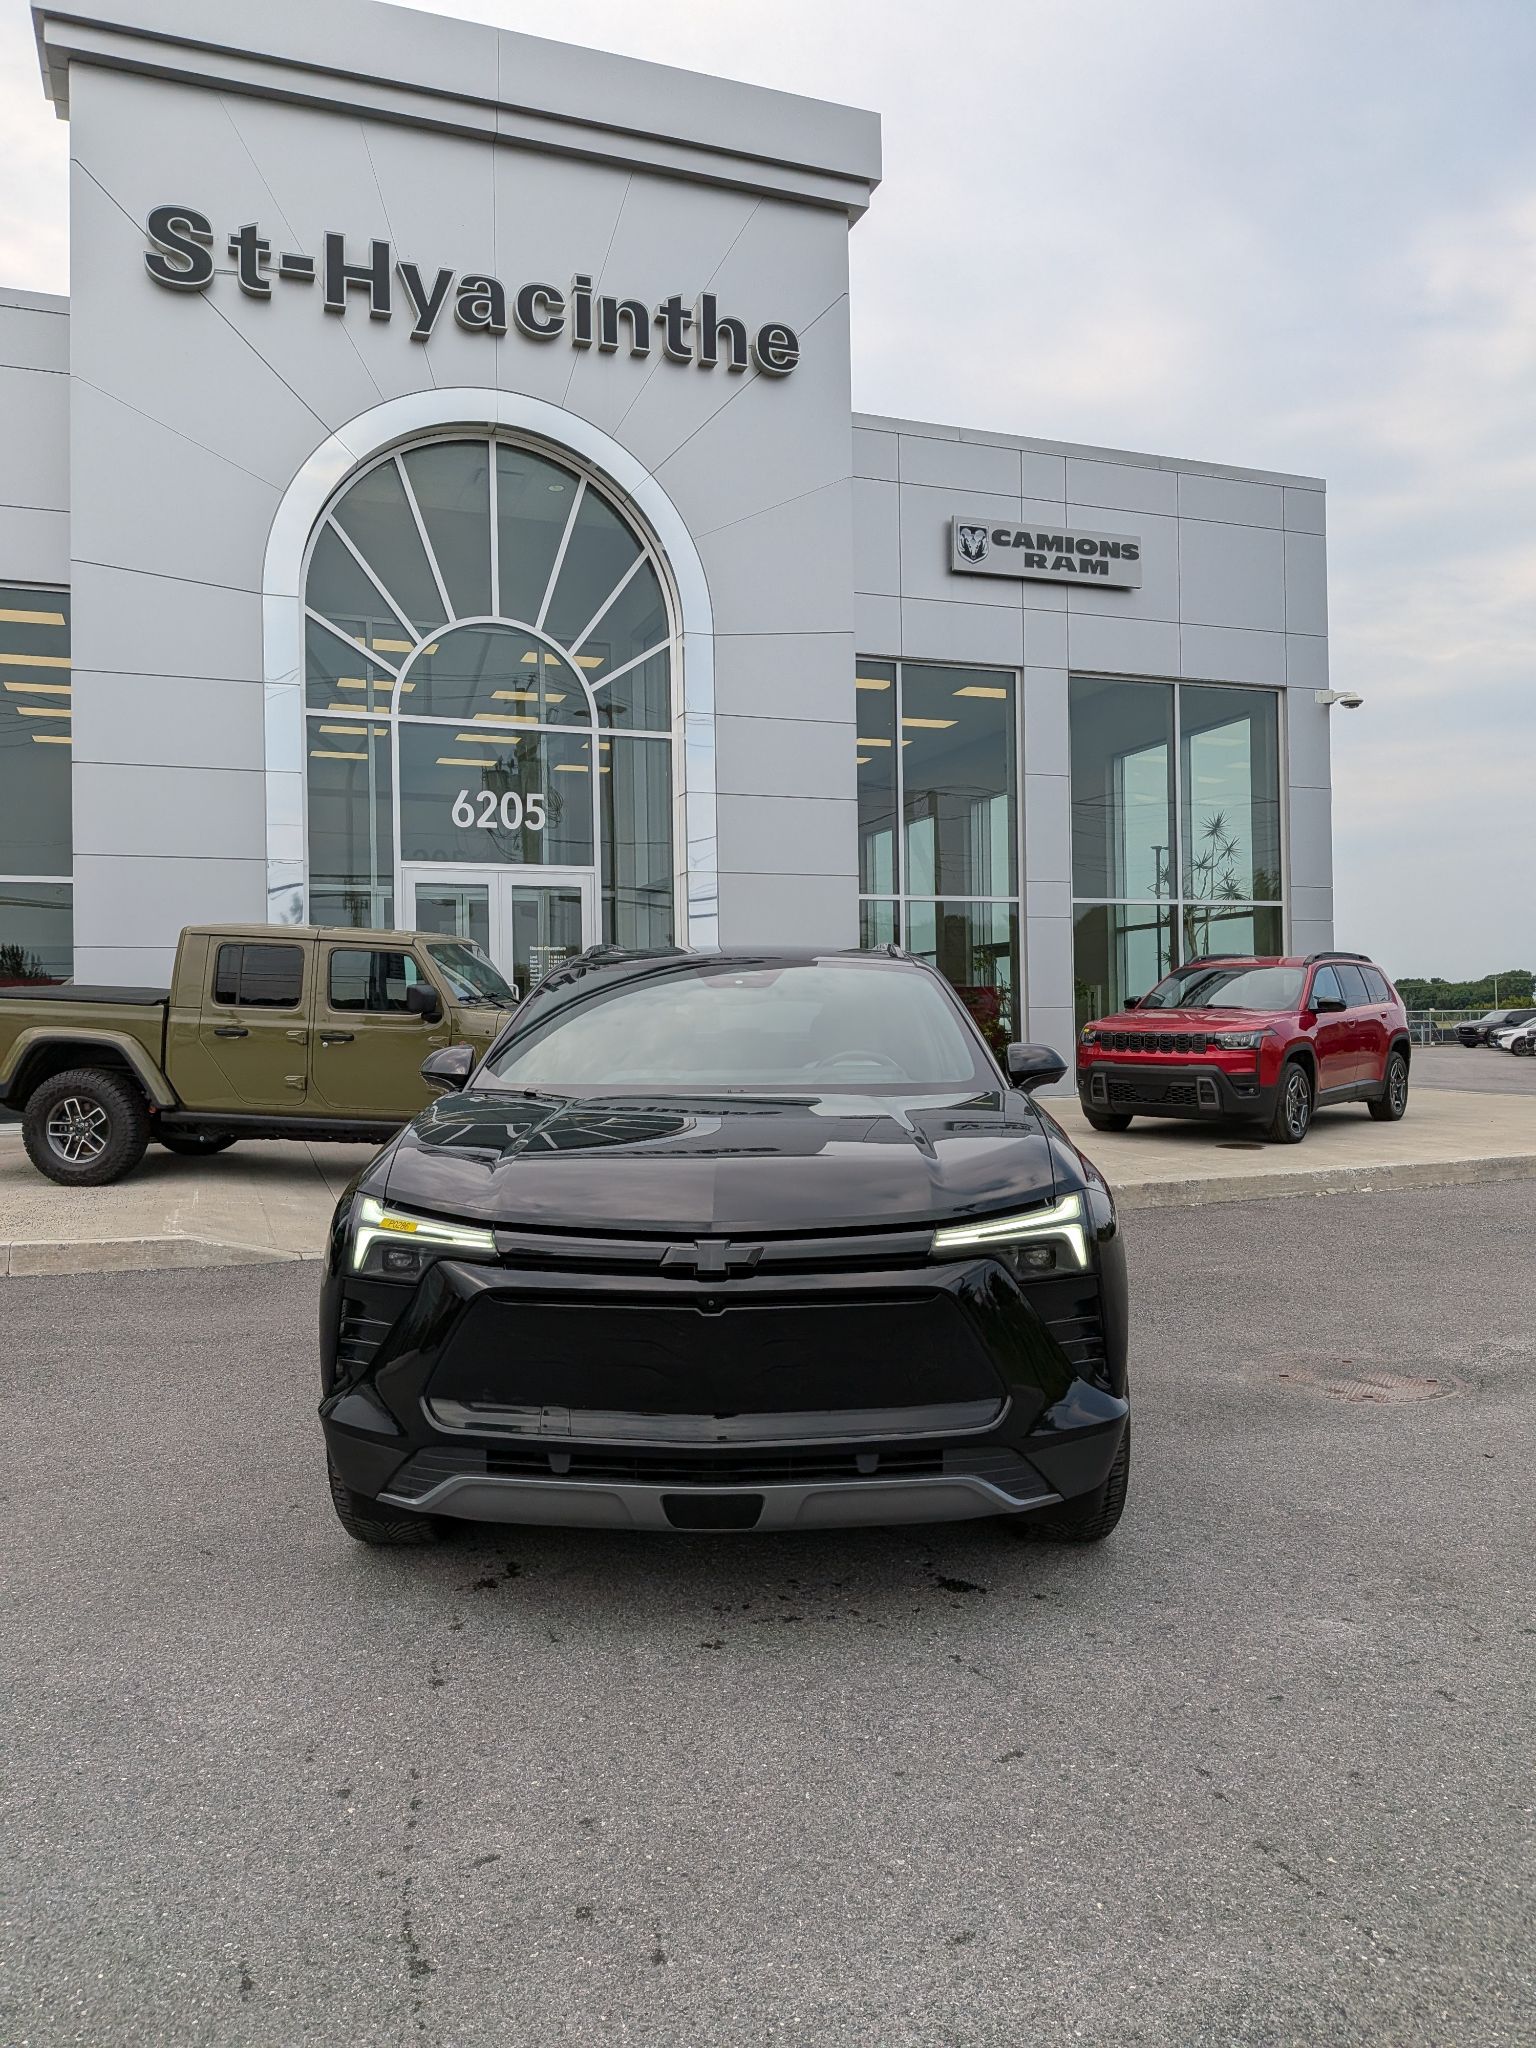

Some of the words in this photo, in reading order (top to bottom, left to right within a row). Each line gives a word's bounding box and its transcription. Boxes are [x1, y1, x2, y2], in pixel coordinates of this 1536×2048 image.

[143, 204, 800, 378] St-Hyacinthe
[991, 529, 1140, 560] CAMIONS
[1024, 552, 1109, 575] RAM
[451, 789, 546, 830] 6205
